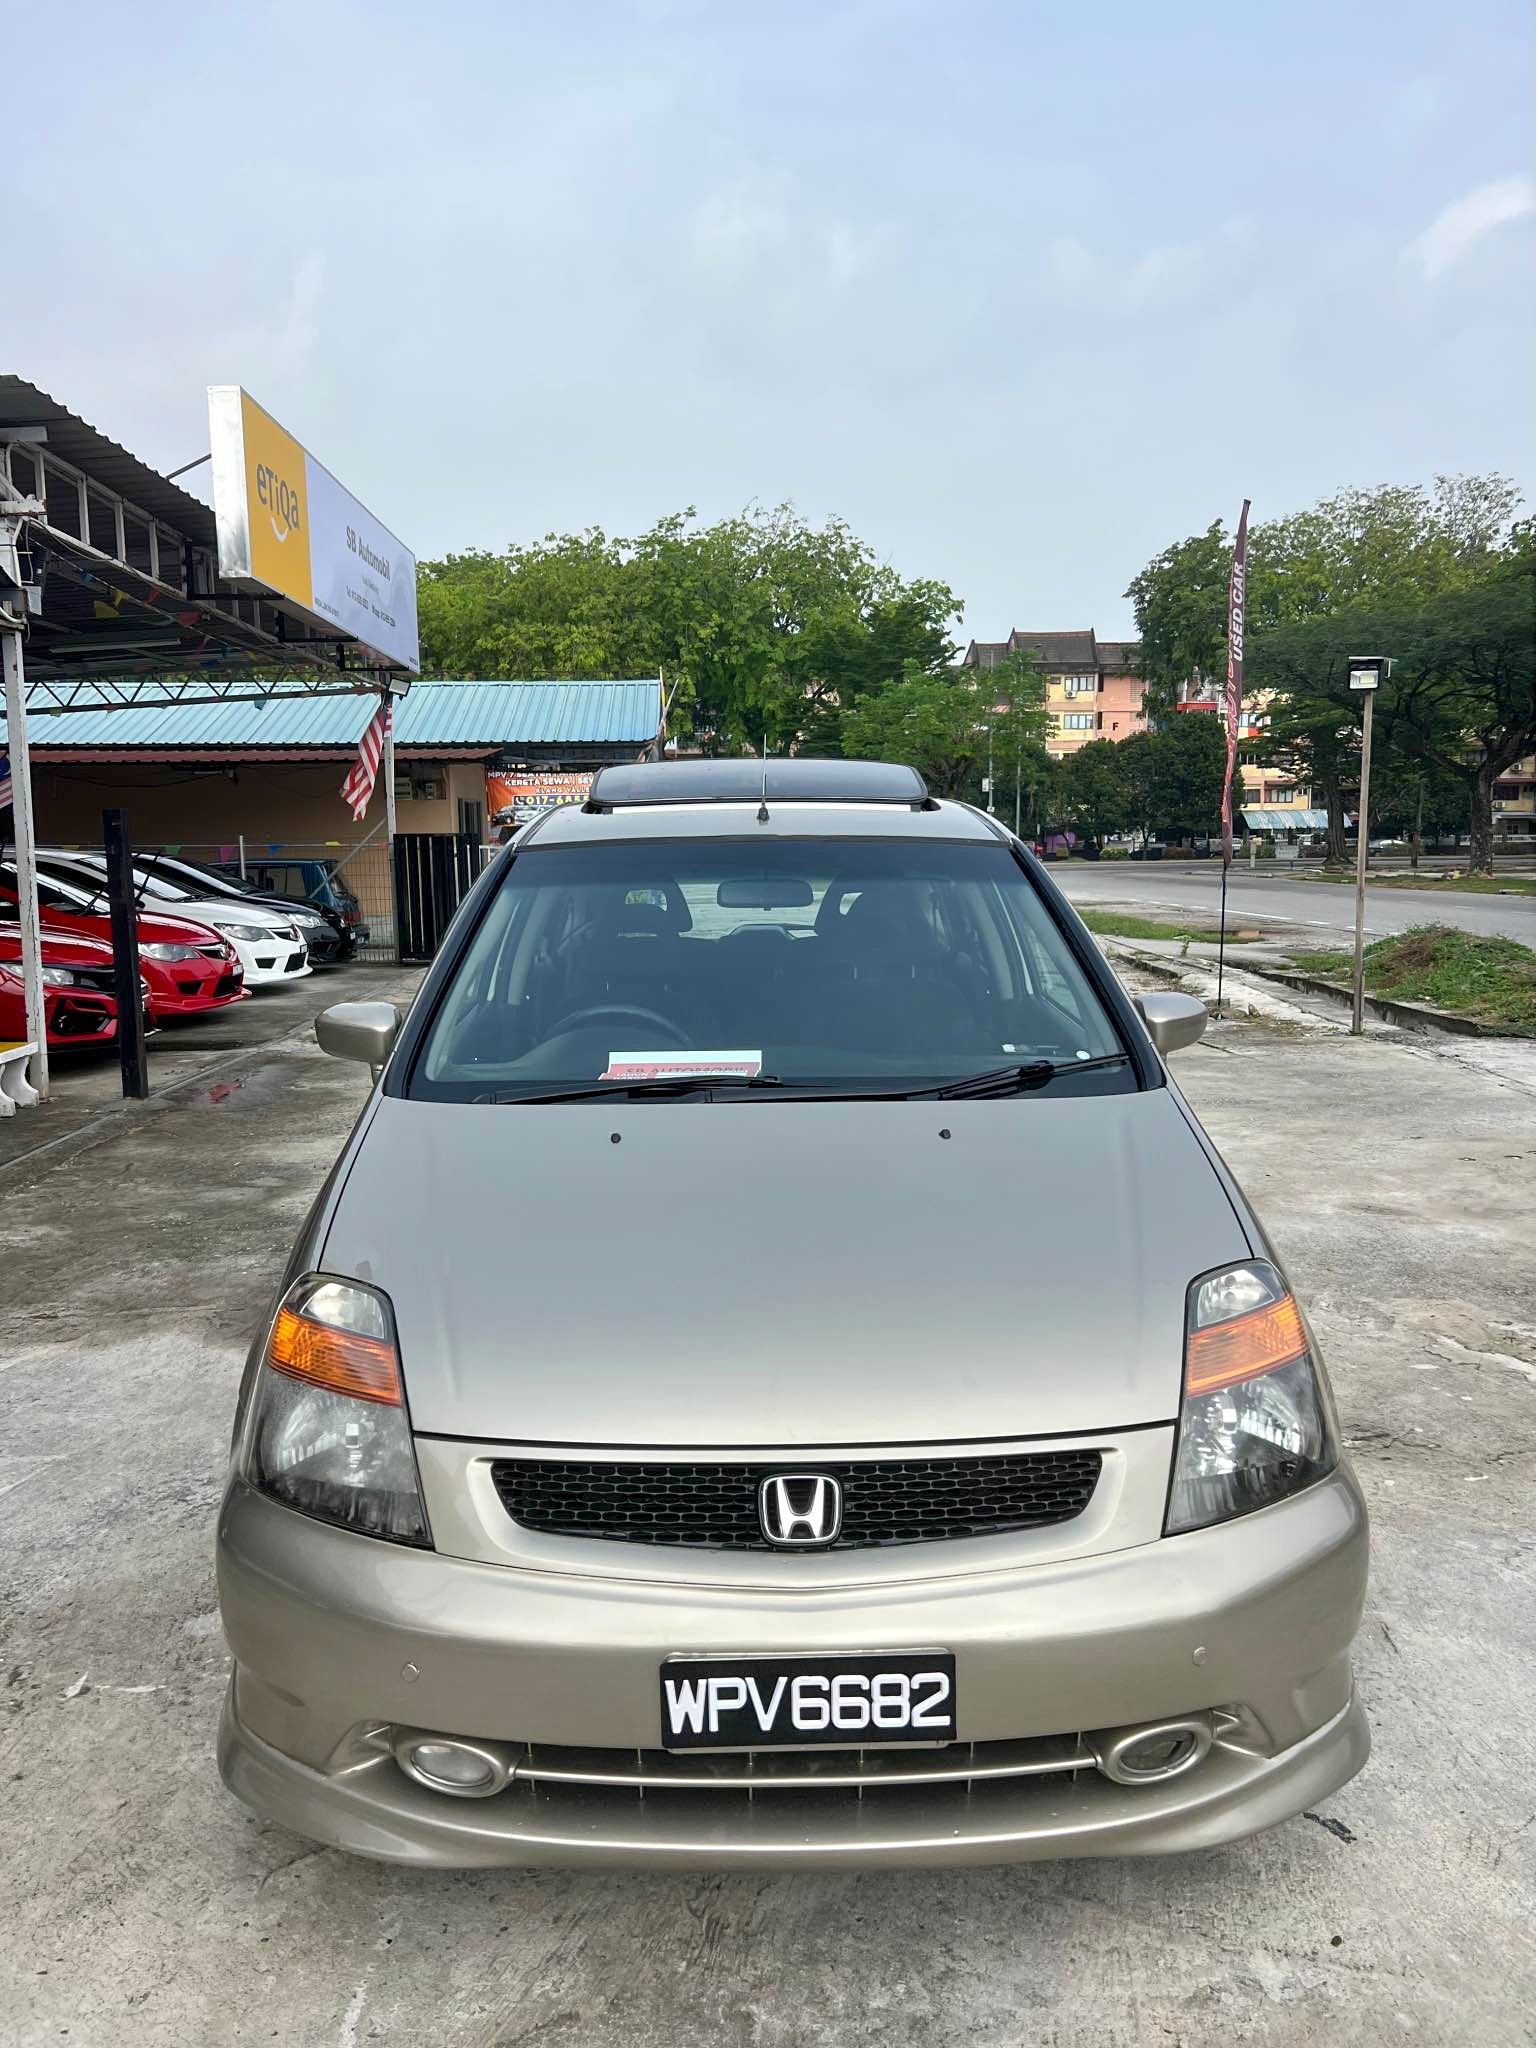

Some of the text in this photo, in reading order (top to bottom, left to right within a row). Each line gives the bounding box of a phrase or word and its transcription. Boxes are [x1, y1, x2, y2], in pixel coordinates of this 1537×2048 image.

[346, 525, 391, 582] SB Automobil
[1232, 561, 1244, 662] USED CAR
[1112, 722, 1119, 731] F
[505, 778, 541, 786] KERETA
[543, 777, 570, 785] SEWA
[664, 1671, 951, 1734] WPV6682
